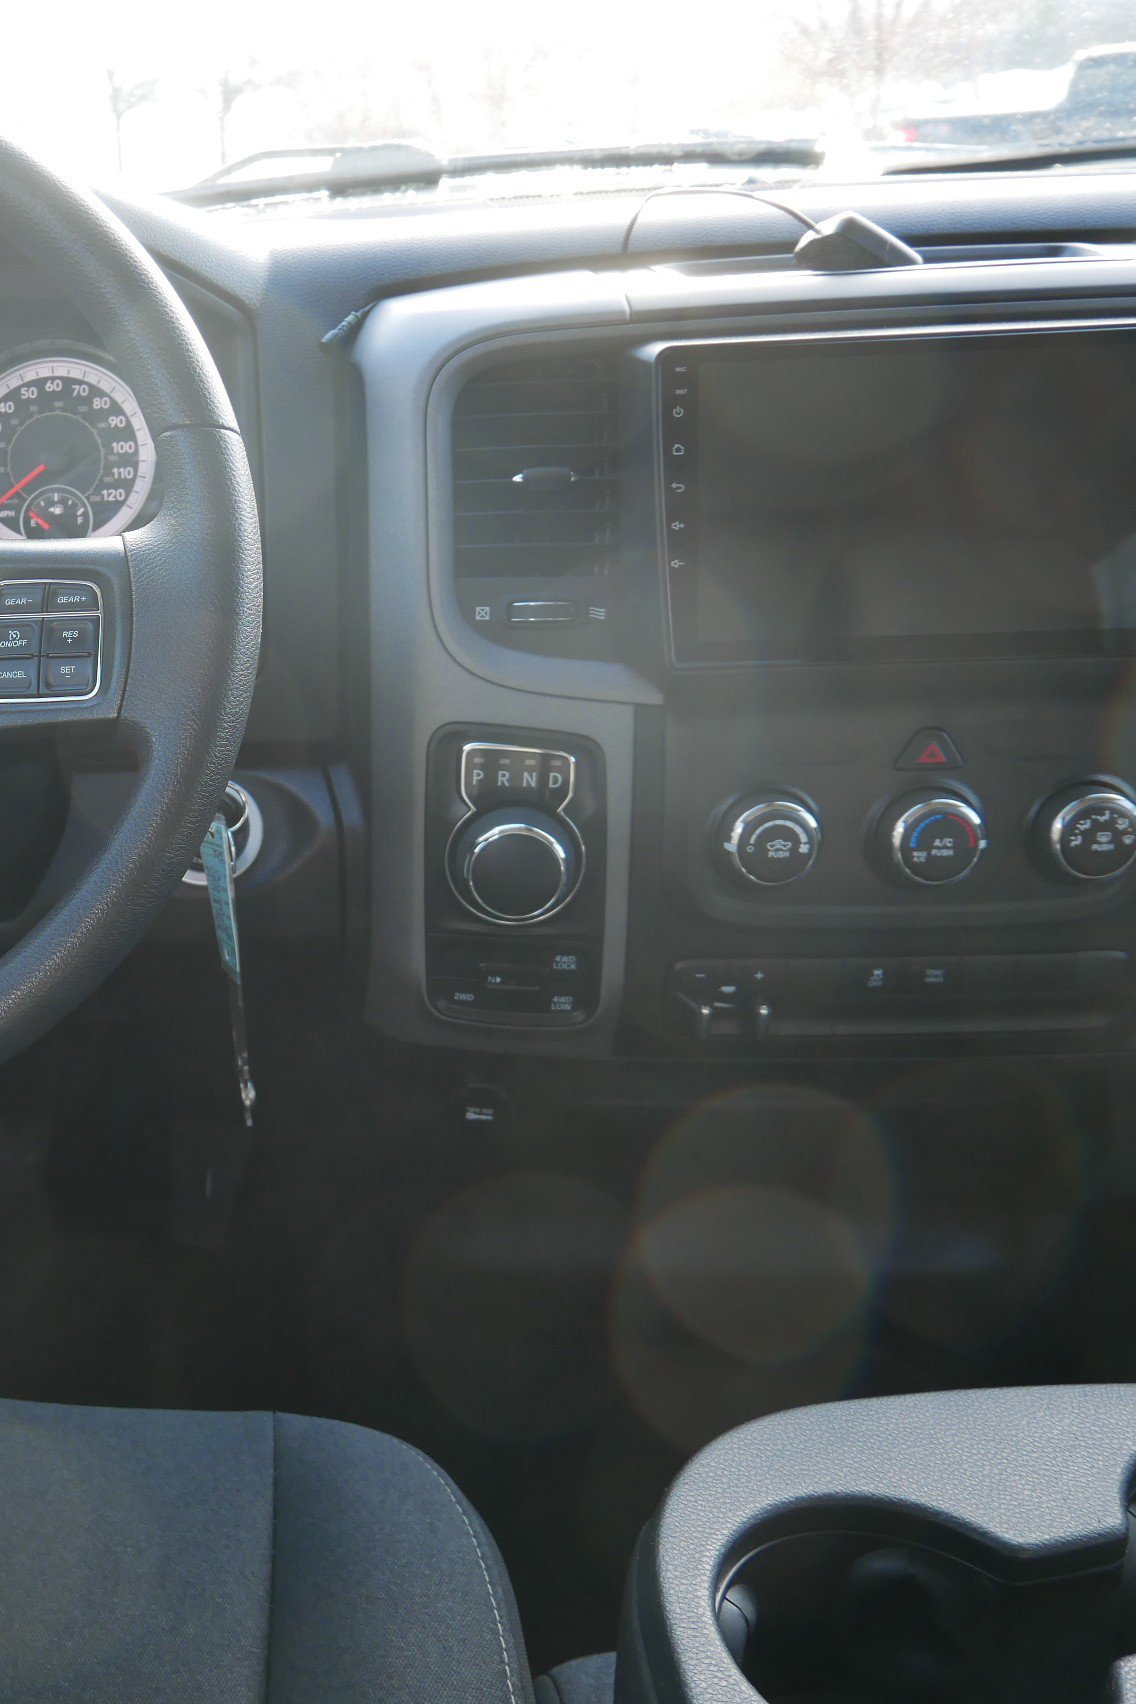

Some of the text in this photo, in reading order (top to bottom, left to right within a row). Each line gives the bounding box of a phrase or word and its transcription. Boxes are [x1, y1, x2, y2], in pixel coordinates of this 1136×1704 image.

[45, 379, 63, 391] 60
[71, 384, 89, 397] 70
[20, 386, 38, 399] 50
[92, 397, 111, 409] 80
[108, 415, 126, 428] 90
[111, 441, 135, 453] 100
[112, 467, 134, 479] 110
[101, 489, 125, 501] 120
[31, 518, 38, 527] E
[77, 516, 84, 525] F
[62, 630, 79, 638] RES
[0, 640, 27, 648] ON/OFF
[472, 769, 562, 788] P R N D
[933, 837, 953, 847] A/C
